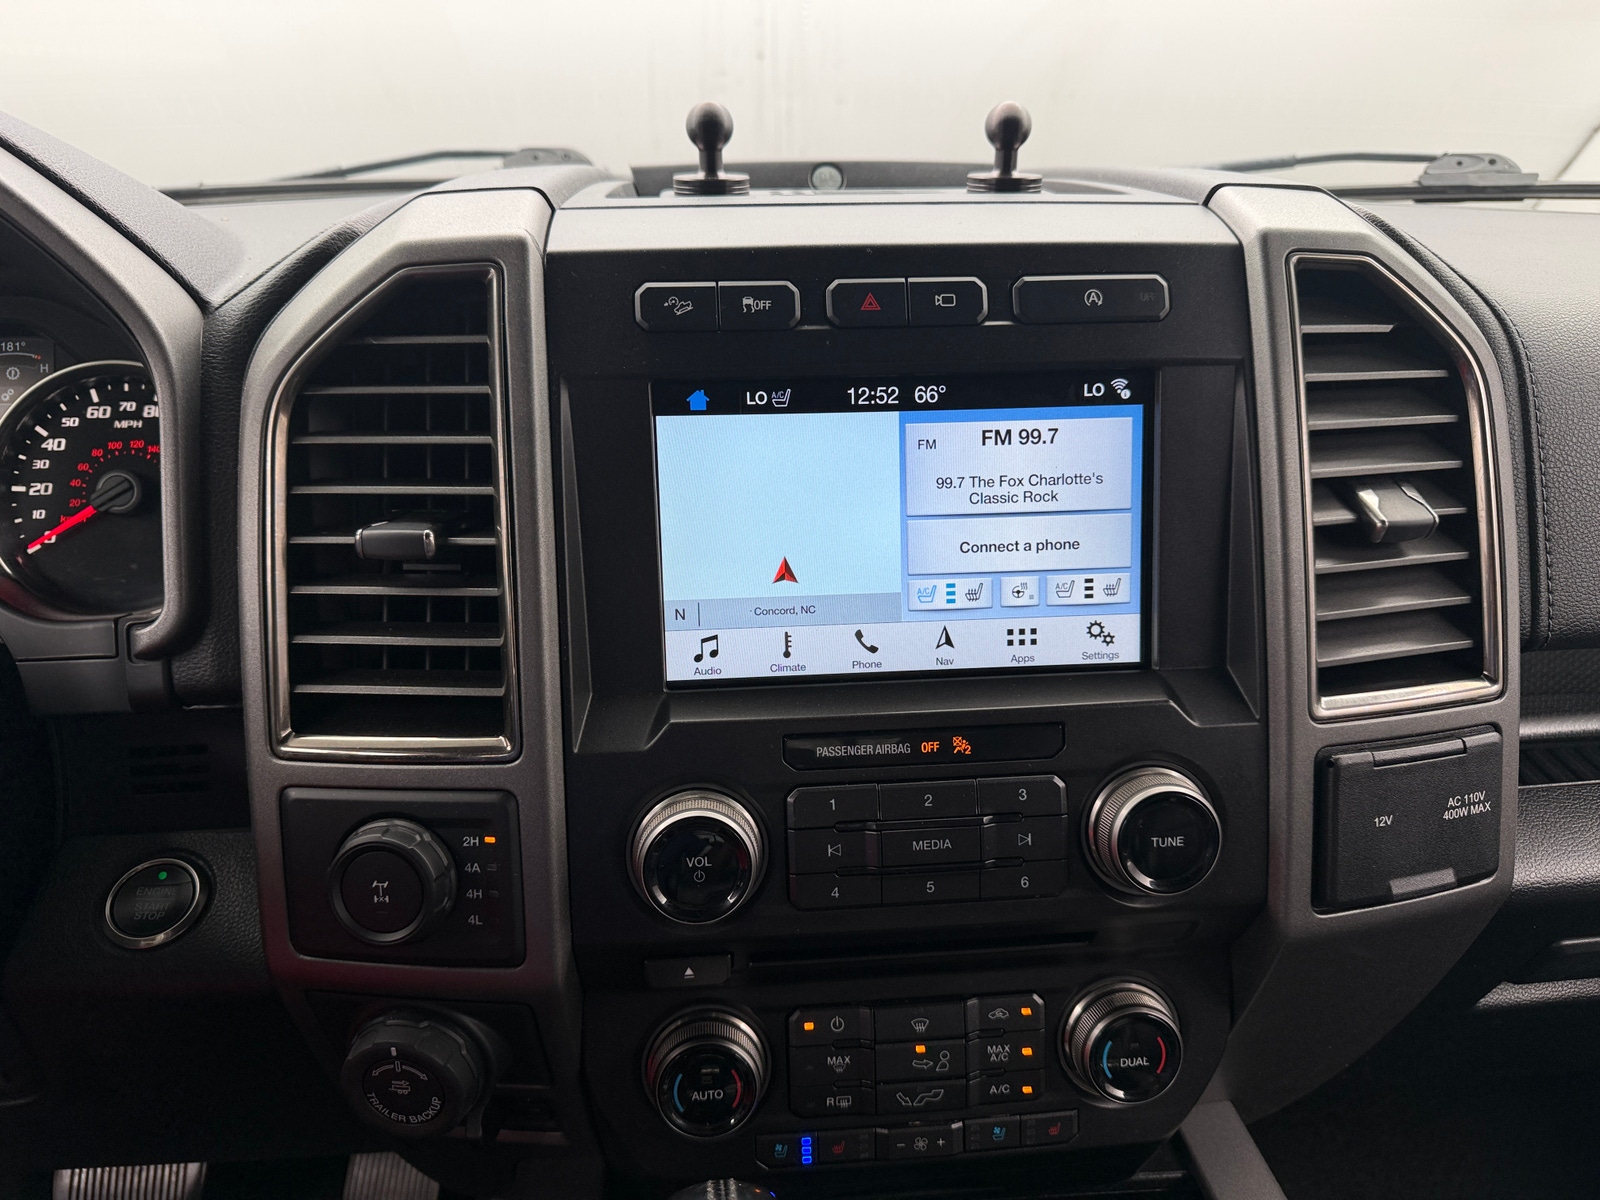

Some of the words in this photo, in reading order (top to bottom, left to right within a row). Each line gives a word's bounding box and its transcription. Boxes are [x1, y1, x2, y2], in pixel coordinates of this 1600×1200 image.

[754, 300, 772, 310] OFF
[40, 363, 49, 373] H
[771, 390, 784, 399] A/C
[847, 386, 899, 405] 12:52
[914, 385, 946, 403] 66°
[1083, 383, 1105, 397] LO
[746, 391, 767, 405] LO
[86, 405, 112, 419] 60
[119, 401, 137, 412] 70
[61, 417, 79, 427] 50
[113, 419, 143, 429] MPH
[981, 428, 1012, 446] FM
[1018, 427, 1059, 445] 99.7
[41, 438, 66, 451] 40
[107, 441, 123, 450] 100
[129, 440, 145, 449] 120
[917, 439, 937, 450] FM
[91, 448, 104, 457] 80
[32, 459, 50, 469] 30
[77, 462, 90, 472] 60
[69, 478, 82, 487] 40
[936, 476, 966, 490] 99.7
[969, 475, 995, 488] The
[999, 474, 1025, 487] Fox
[1028, 472, 1104, 486] Charlotte's
[28, 482, 53, 496] 20
[69, 498, 81, 507] 20
[969, 490, 1019, 505] Classic
[1023, 490, 1059, 503] Rock
[32, 509, 46, 519] 10
[959, 540, 1020, 554] Connect
[1023, 542, 1032, 551] a
[1036, 538, 1081, 554] phone
[916, 586, 931, 596] A/C
[1055, 581, 1071, 591] A/C
[674, 608, 686, 620] N
[753, 605, 799, 617] Concord,
[800, 605, 817, 615] NC
[935, 657, 955, 667] Nav
[1010, 654, 1036, 665] Apps
[1081, 651, 1120, 663] Settings
[769, 663, 807, 674] Climate
[851, 660, 883, 670] Phone
[693, 667, 723, 677] Audio
[816, 745, 874, 758] PASSENGER
[875, 743, 911, 755] AIRBAG
[920, 741, 940, 753] OFF
[1018, 788, 1028, 801] 3
[1447, 795, 1462, 808] AC
[1463, 790, 1486, 805] 110V
[829, 799, 836, 811] 1
[924, 794, 933, 807] 2
[1442, 806, 1469, 820] 400W
[1470, 801, 1492, 815] MAX
[1374, 815, 1393, 827] 12V
[462, 836, 480, 847] 2H
[912, 838, 952, 851] MEDIA
[1150, 836, 1185, 848] TUNE
[686, 856, 713, 868] VOL
[464, 864, 481, 873] 4A
[925, 880, 935, 893] 5
[1020, 875, 1030, 889] 6
[136, 887, 177, 896] ENGINE
[466, 889, 483, 899] 4H
[830, 887, 840, 899] 4
[134, 911, 165, 920] STOP
[468, 915, 483, 925] 4L
[987, 1044, 1011, 1054] MAX
[827, 1055, 851, 1066] MAX
[990, 1052, 1009, 1062] A/C
[1120, 1056, 1150, 1067] DUAL
[989, 1084, 1010, 1094] A/C
[691, 1089, 724, 1101] AUTO
[366, 1091, 407, 1123] TRAILER
[408, 1096, 443, 1124] BACKUP
[826, 1098, 834, 1107] R
